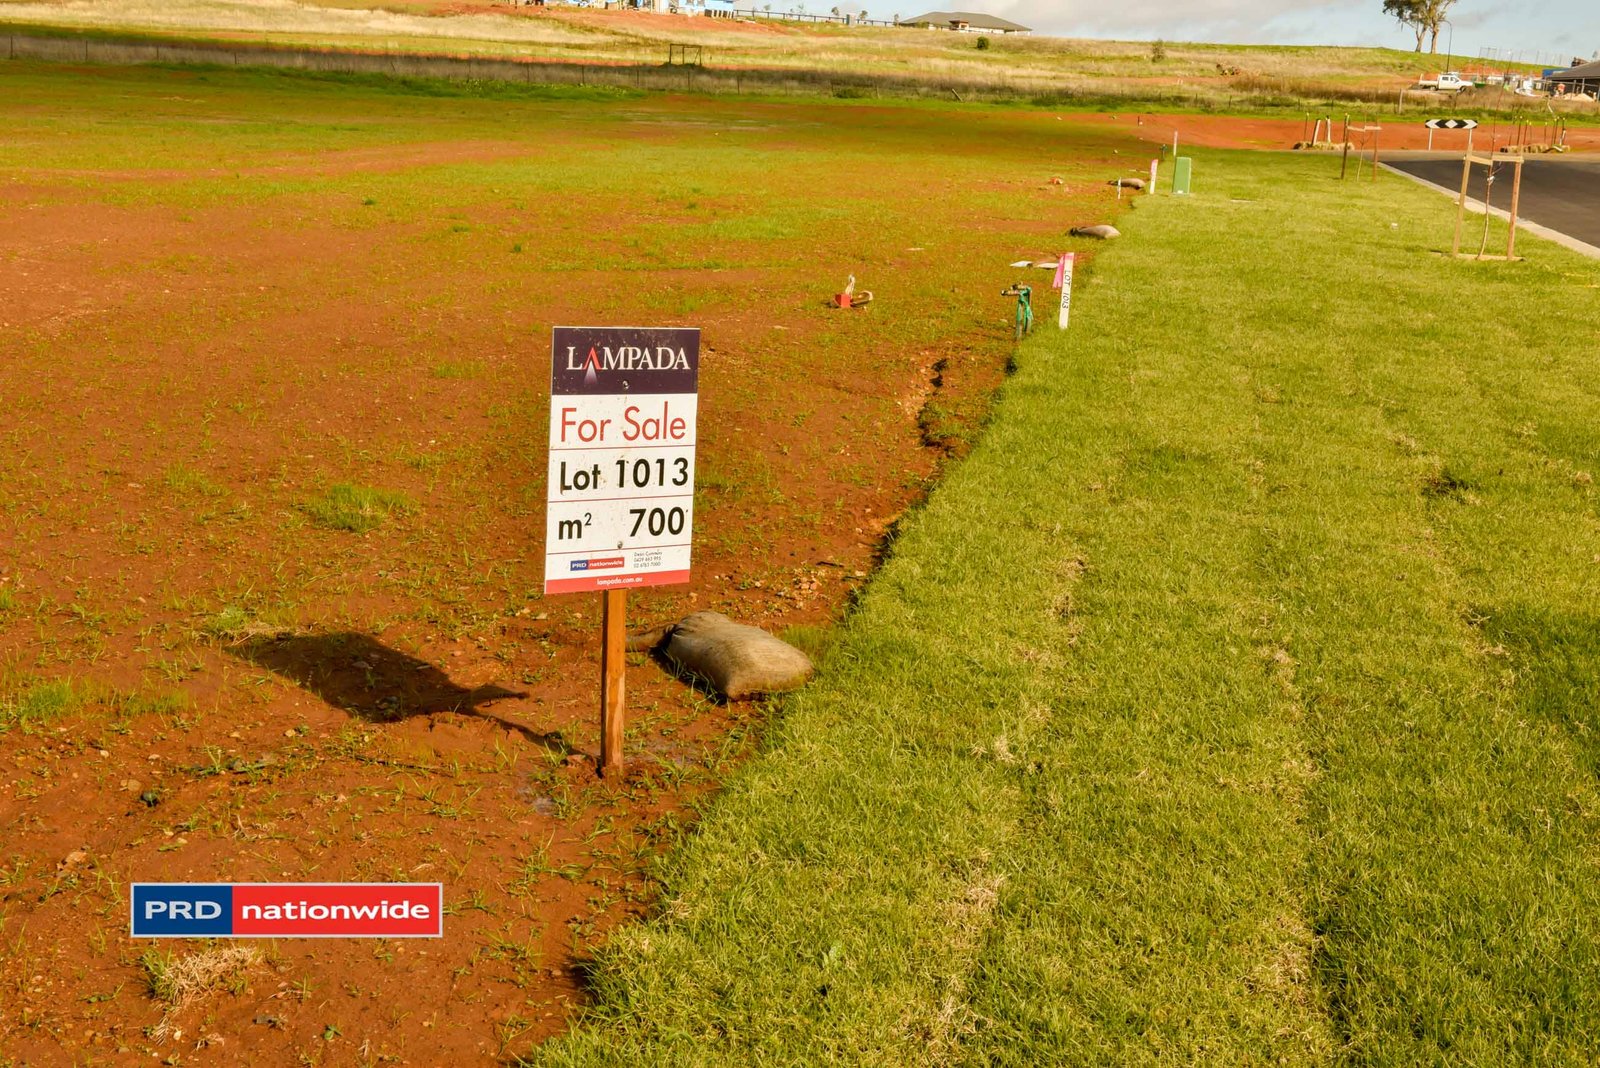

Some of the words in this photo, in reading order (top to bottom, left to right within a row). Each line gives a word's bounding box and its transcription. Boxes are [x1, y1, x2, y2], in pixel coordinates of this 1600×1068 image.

[1061, 292, 1070, 309] 1013
[566, 346, 692, 371] LAMPADA
[560, 407, 612, 442] For
[622, 400, 686, 441] Sale
[560, 461, 601, 491] Lot
[615, 457, 689, 488] 1013
[629, 506, 685, 538] 700
[589, 559, 624, 568] nationwide
[597, 577, 643, 586] lampada.com.au
